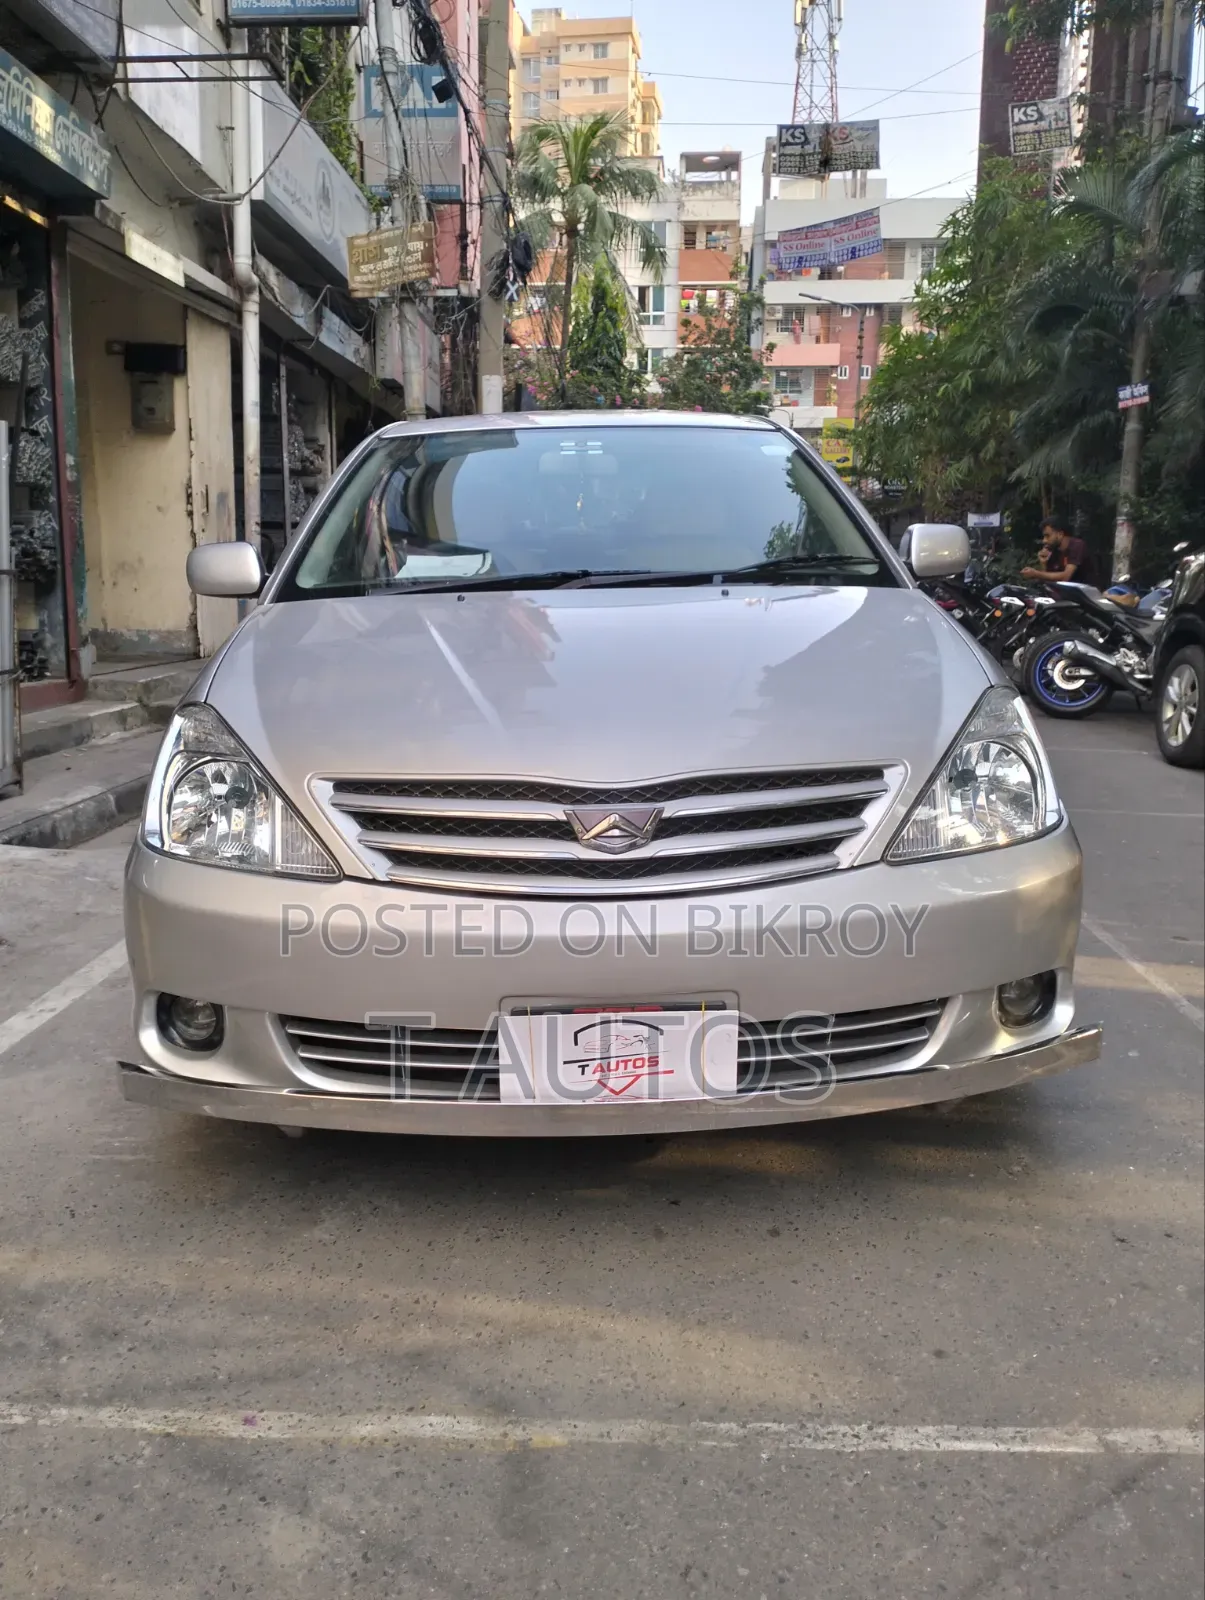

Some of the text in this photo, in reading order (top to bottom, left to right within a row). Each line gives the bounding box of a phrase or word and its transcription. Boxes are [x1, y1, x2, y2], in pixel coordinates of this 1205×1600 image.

[1013, 105, 1038, 123] KS
[781, 129, 805, 142] KS
[834, 236, 844, 245] SS
[847, 228, 877, 241] Online
[783, 240, 825, 251] SS Online
[577, 1064, 589, 1075] T
[592, 1056, 660, 1075] AUTOS
